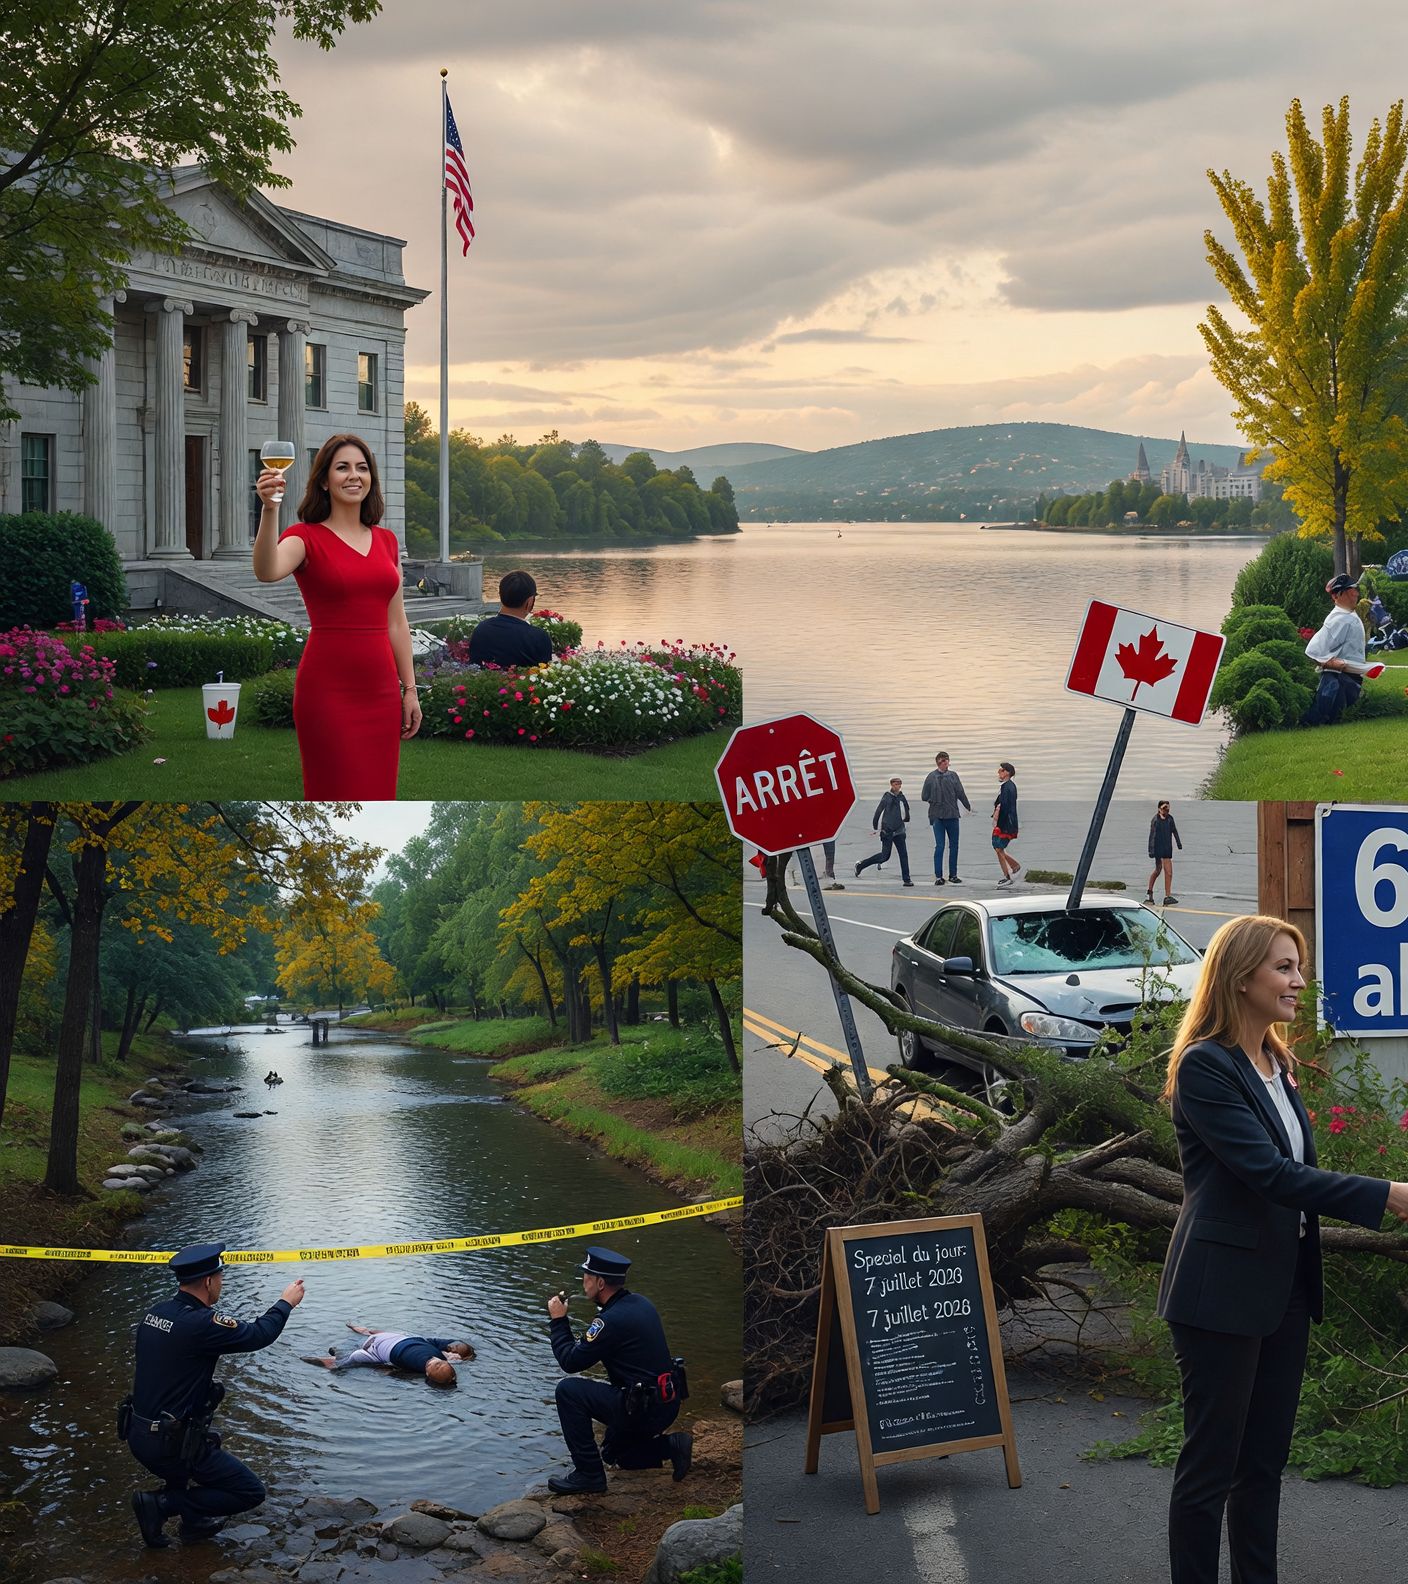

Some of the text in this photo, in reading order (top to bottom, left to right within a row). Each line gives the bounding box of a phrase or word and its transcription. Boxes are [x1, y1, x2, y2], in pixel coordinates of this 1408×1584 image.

[736, 749, 838, 815] ARRÊT
[913, 1245, 930, 1263] du
[935, 1244, 967, 1264] jour:
[864, 1277, 876, 1295] 7
[880, 1271, 922, 1297] juillet
[867, 1310, 878, 1328] 7
[883, 1304, 930, 1332] juillet
